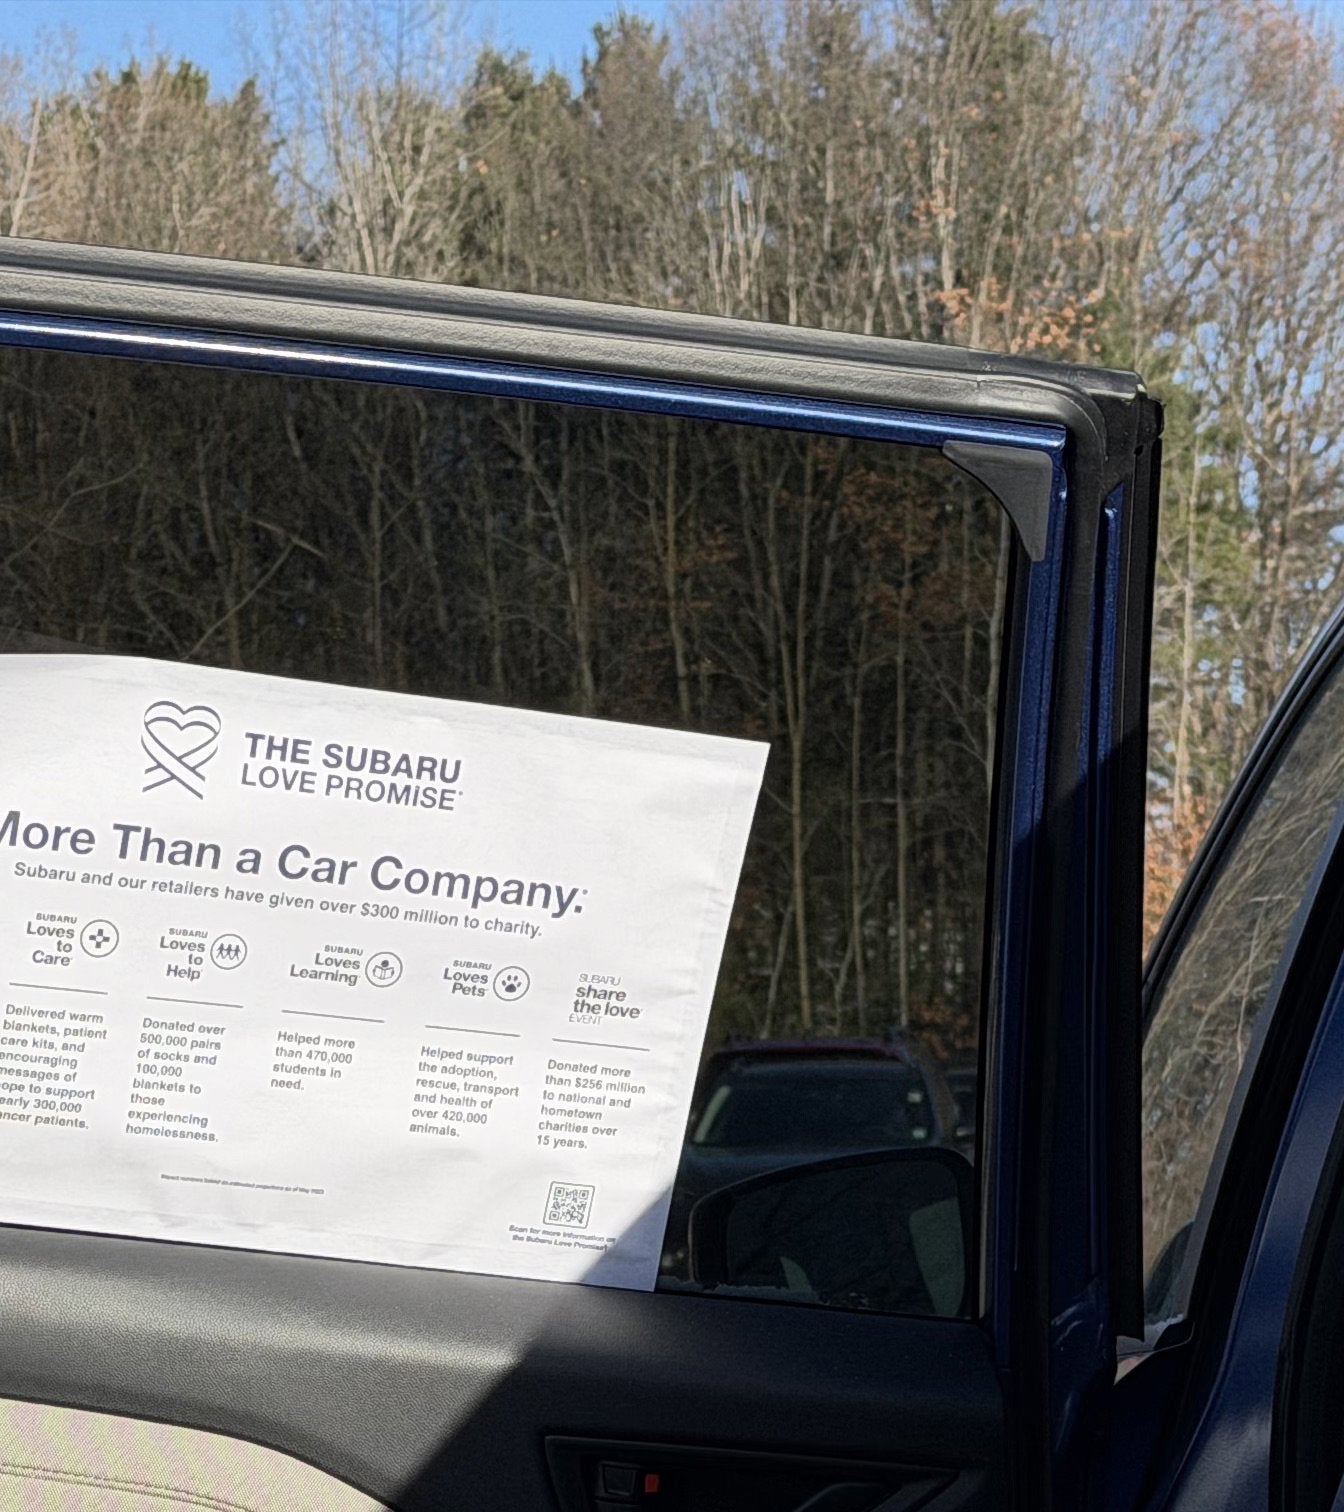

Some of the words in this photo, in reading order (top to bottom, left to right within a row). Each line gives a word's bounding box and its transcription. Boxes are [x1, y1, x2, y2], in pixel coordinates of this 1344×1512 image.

[244, 731, 312, 765] THE
[321, 743, 462, 784] SUBARU
[240, 762, 317, 794] LOVE
[324, 773, 457, 811] PROMISE
[112, 822, 221, 870] Than
[235, 848, 262, 875] a
[277, 844, 358, 886] Car
[370, 855, 584, 919] Company.
[13, 861, 76, 882] Subaru
[80, 871, 114, 886] and
[117, 876, 148, 890] our
[150, 879, 220, 898] retailers
[223, 885, 265, 904] have
[268, 891, 315, 910] given
[318, 900, 357, 914] over
[359, 901, 400, 920] $300
[403, 908, 459, 927] million
[463, 914, 480, 929] to
[484, 917, 542, 939] charity.
[35, 912, 78, 925] SUBARU
[26, 920, 75, 939] Loves
[168, 927, 209, 939] SUBARU
[56, 939, 73, 953] to
[159, 935, 206, 953] Loves
[323, 944, 364, 957] SUBARU
[31, 949, 71, 967] Care
[187, 953, 204, 966] to
[314, 952, 361, 970] Loves
[452, 959, 493, 971] SUBARU
[165, 963, 201, 982] Help
[289, 963, 358, 987] Learning
[442, 967, 489, 985] Loves
[578, 972, 622, 987] SUBARU
[451, 981, 486, 997] Pets
[575, 984, 627, 1002] share
[5, 1003, 66, 1020] Delivered
[68, 1012, 104, 1024] warm
[573, 998, 602, 1015] the
[603, 1001, 640, 1019] love
[142, 1017, 195, 1033] Donated
[197, 1024, 226, 1035] over
[568, 1013, 601, 1025] EVENT
[2, 1018, 60, 1037] blankets,
[62, 1026, 107, 1040] patient
[0, 1036, 29, 1048] care
[31, 1036, 58, 1052] kits,
[60, 1041, 86, 1053] and
[139, 1032, 188, 1047] 500,000
[189, 1038, 221, 1051] pairs
[277, 1030, 321, 1046] Helped
[323, 1037, 356, 1049] more
[136, 1047, 151, 1059] of
[153, 1050, 190, 1063] socks
[193, 1054, 218, 1066] and
[275, 1046, 303, 1059] than
[305, 1049, 353, 1064] 470,000
[420, 1045, 464, 1061] Helped
[466, 1052, 514, 1066] support
[63, 1071, 78, 1082] of
[136, 1062, 183, 1078] 100,000
[272, 1062, 327, 1077] students
[329, 1066, 342, 1079] in
[418, 1061, 438, 1073] the
[440, 1064, 497, 1081] adoption,
[547, 1058, 598, 1074] Donated
[600, 1066, 631, 1078] more
[28, 1083, 42, 1094] to
[44, 1086, 95, 1100] support
[132, 1077, 186, 1093] blankets
[189, 1083, 202, 1095] to
[270, 1078, 305, 1090] need.
[415, 1077, 460, 1093] rescue,
[463, 1081, 520, 1097] transport
[544, 1074, 572, 1087] than
[574, 1076, 603, 1090] $256
[605, 1081, 646, 1094] million
[32, 1098, 83, 1114] 300,000
[130, 1092, 166, 1106] those
[413, 1092, 437, 1104] and
[439, 1093, 477, 1107] health
[480, 1098, 494, 1109] of
[542, 1089, 555, 1101] to
[557, 1092, 607, 1105] national
[608, 1097, 632, 1109] and
[127, 1110, 209, 1129] experiencing
[411, 1108, 439, 1119] over
[441, 1109, 488, 1125] 420,000
[540, 1103, 603, 1121] hometown
[33, 1115, 89, 1130] patients.
[408, 1122, 460, 1137] animals.
[537, 1119, 589, 1134] charities
[591, 1126, 618, 1136] over
[125, 1122, 218, 1142] homelessness.
[536, 1134, 550, 1146] 15
[552, 1137, 588, 1149] years.
